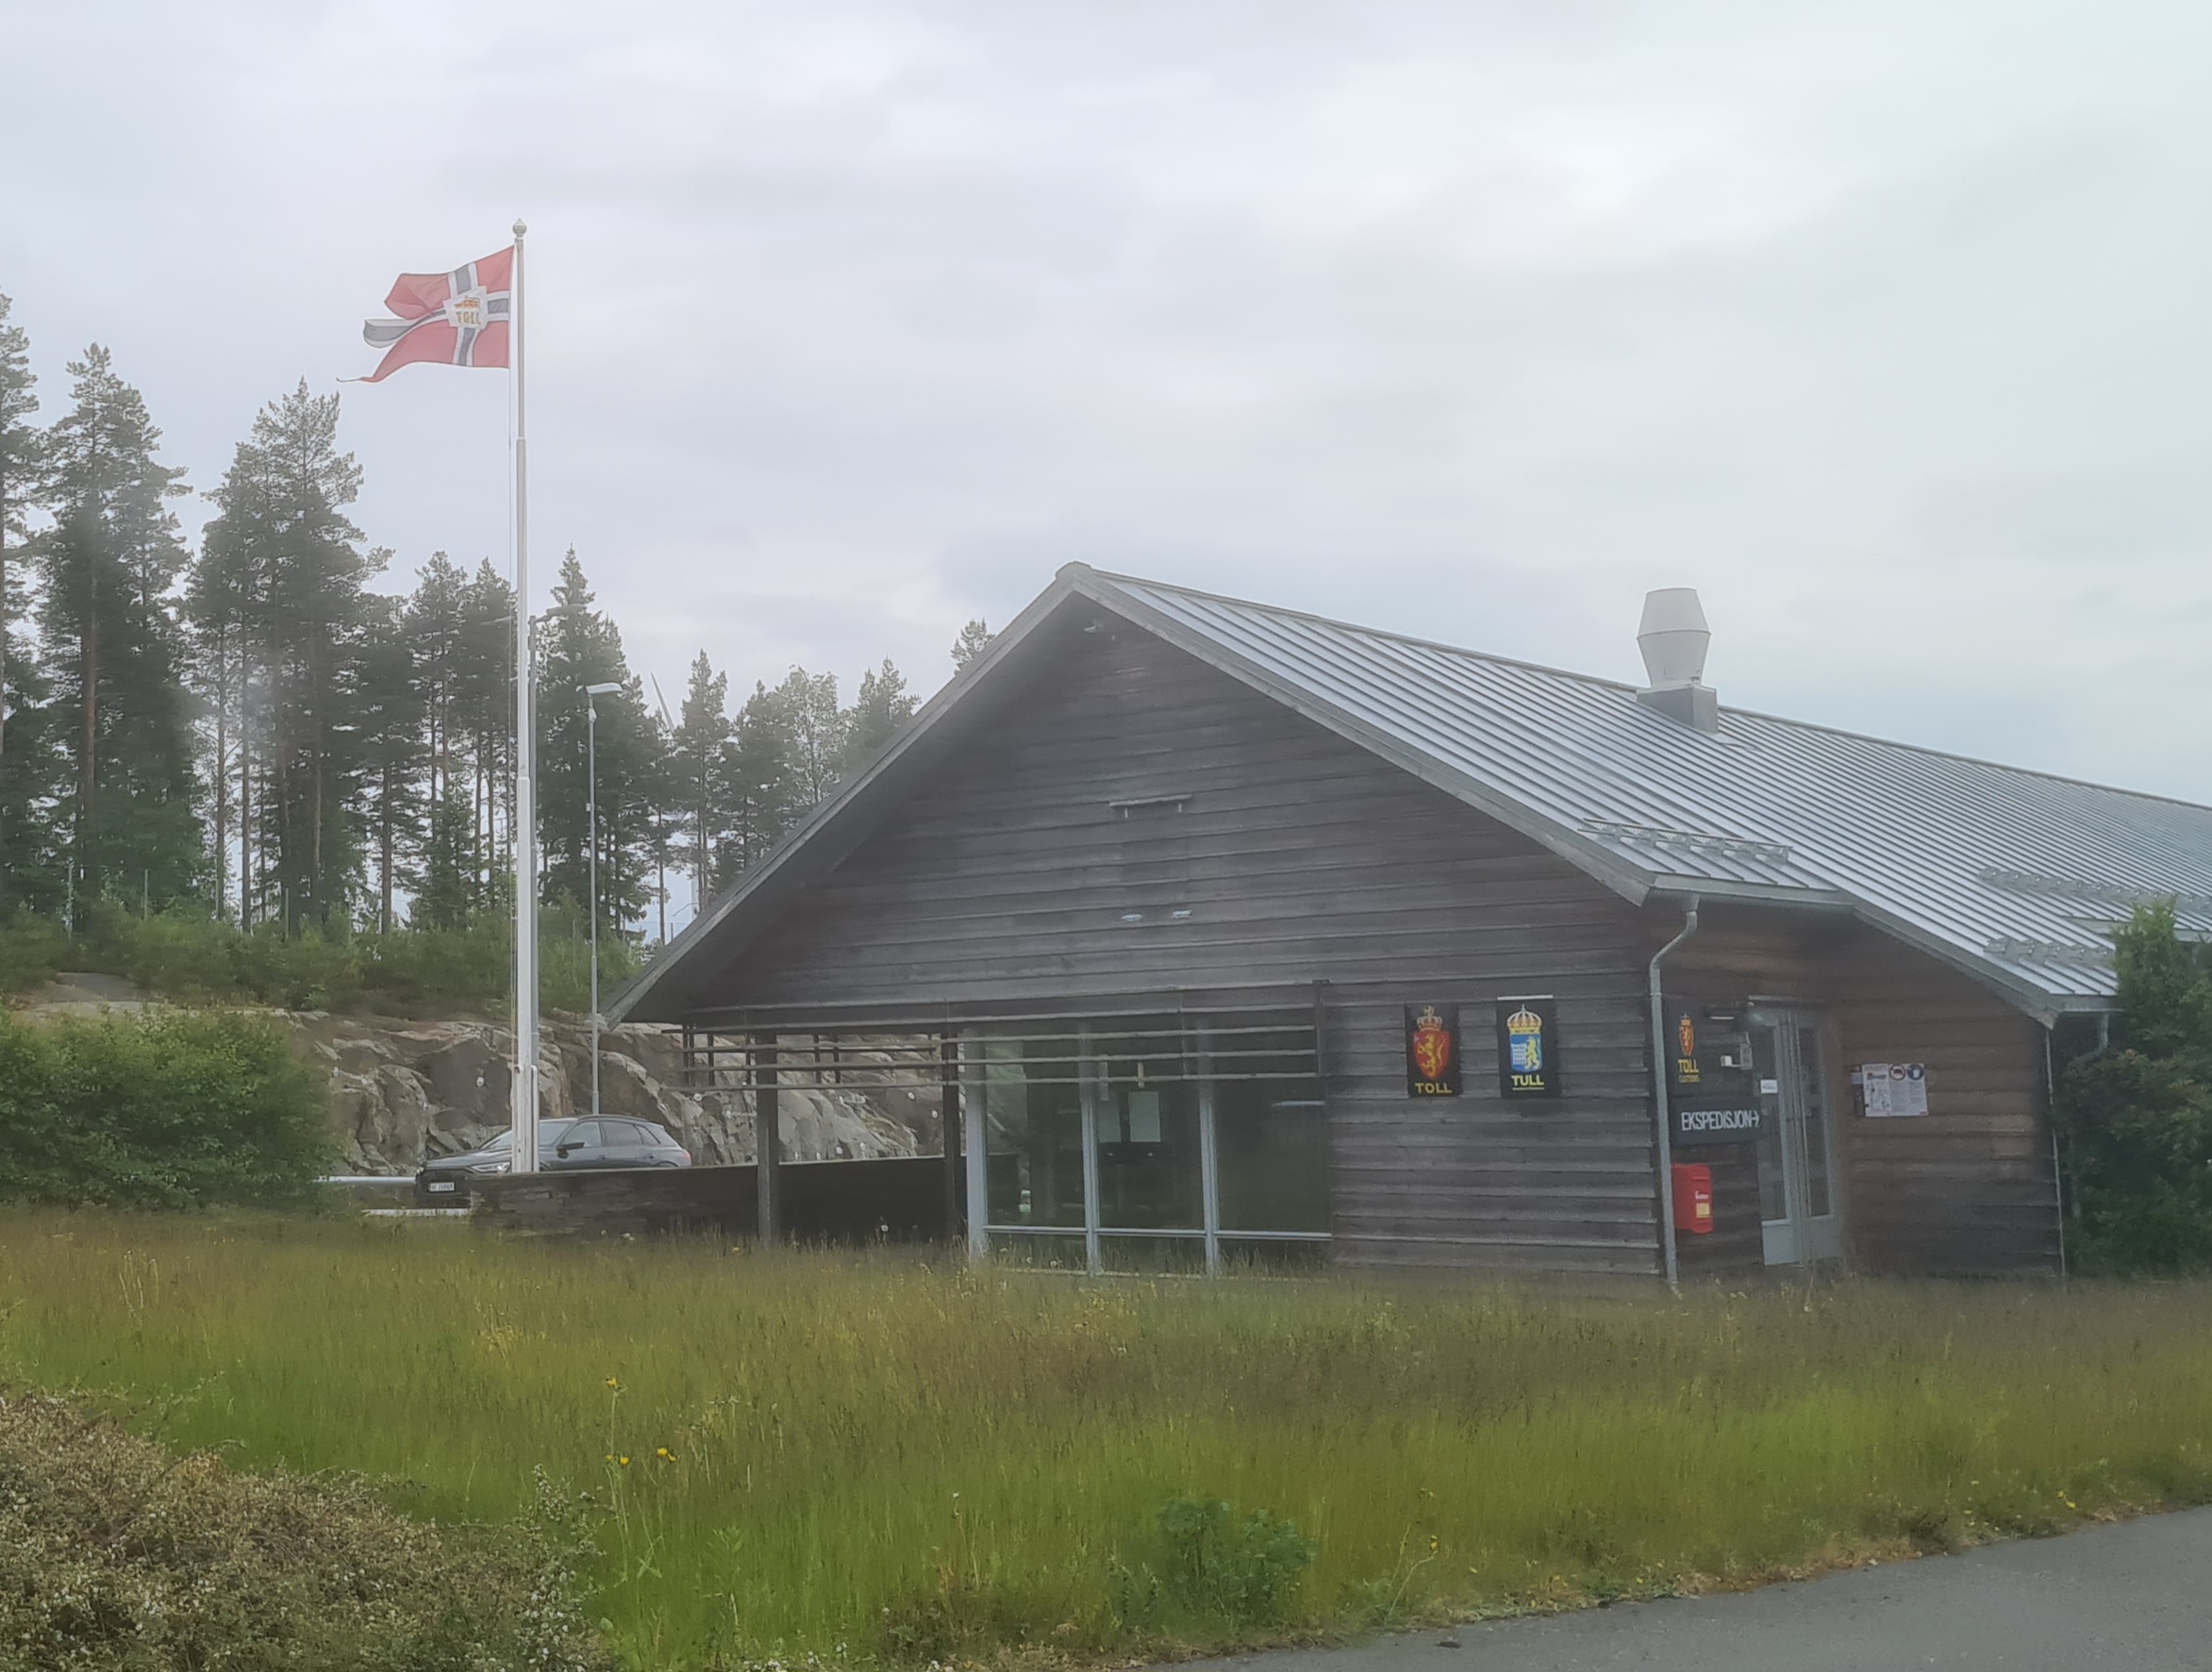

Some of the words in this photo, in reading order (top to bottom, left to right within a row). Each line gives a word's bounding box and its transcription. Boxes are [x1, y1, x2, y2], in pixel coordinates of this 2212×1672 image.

[456, 311, 481, 324] TOLL
[1677, 1059, 1700, 1073] TOLL
[1511, 1075, 1544, 1086] TULL
[1415, 1083, 1453, 1094] TOLL
[1681, 1110, 1752, 1131] EKSPEDISJON
